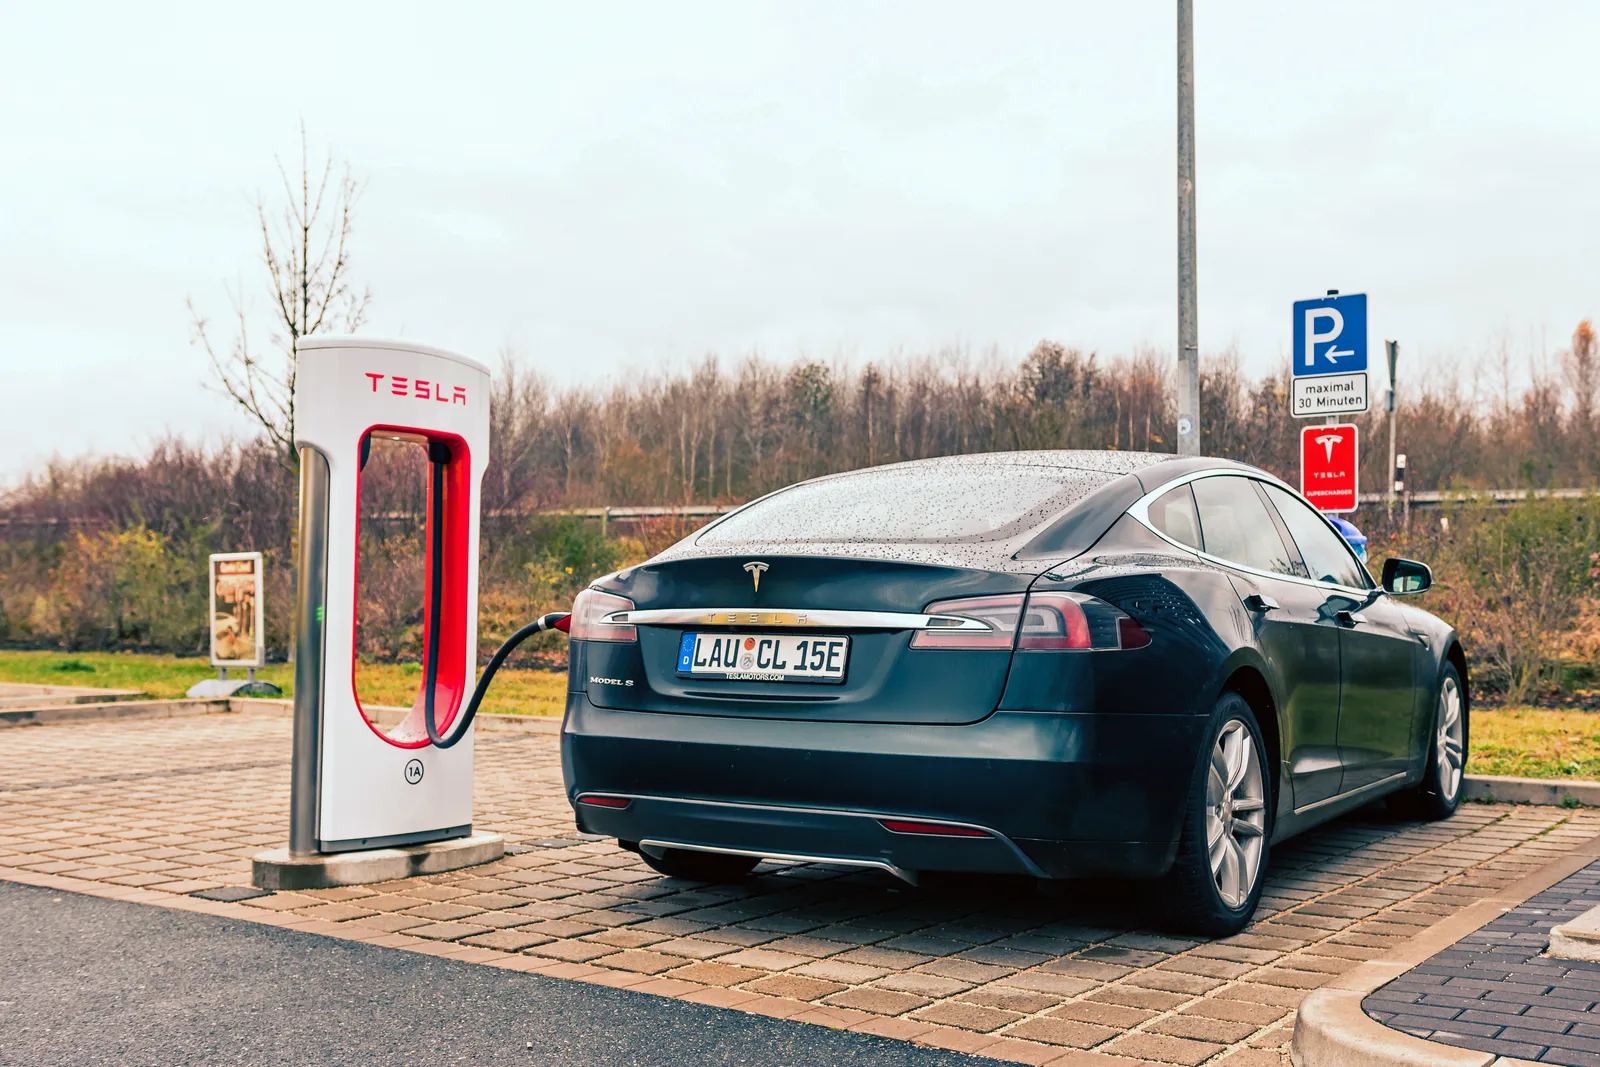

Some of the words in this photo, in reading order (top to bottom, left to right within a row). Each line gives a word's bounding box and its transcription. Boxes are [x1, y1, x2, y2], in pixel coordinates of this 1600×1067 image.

[1305, 307, 1344, 366] P
[365, 373, 467, 406] TESLA
[1305, 381, 1354, 394] maximal
[1299, 398, 1311, 408] 30
[1316, 395, 1362, 407] Minuten
[708, 613, 808, 623] TESLA
[683, 656, 690, 665] D
[693, 637, 740, 668] LAU
[756, 639, 787, 670] CL
[793, 640, 844, 672] 15E
[590, 676, 624, 686] MODEL
[726, 672, 785, 681] TESLAMOTORS.COM
[409, 766, 421, 777] 1A
